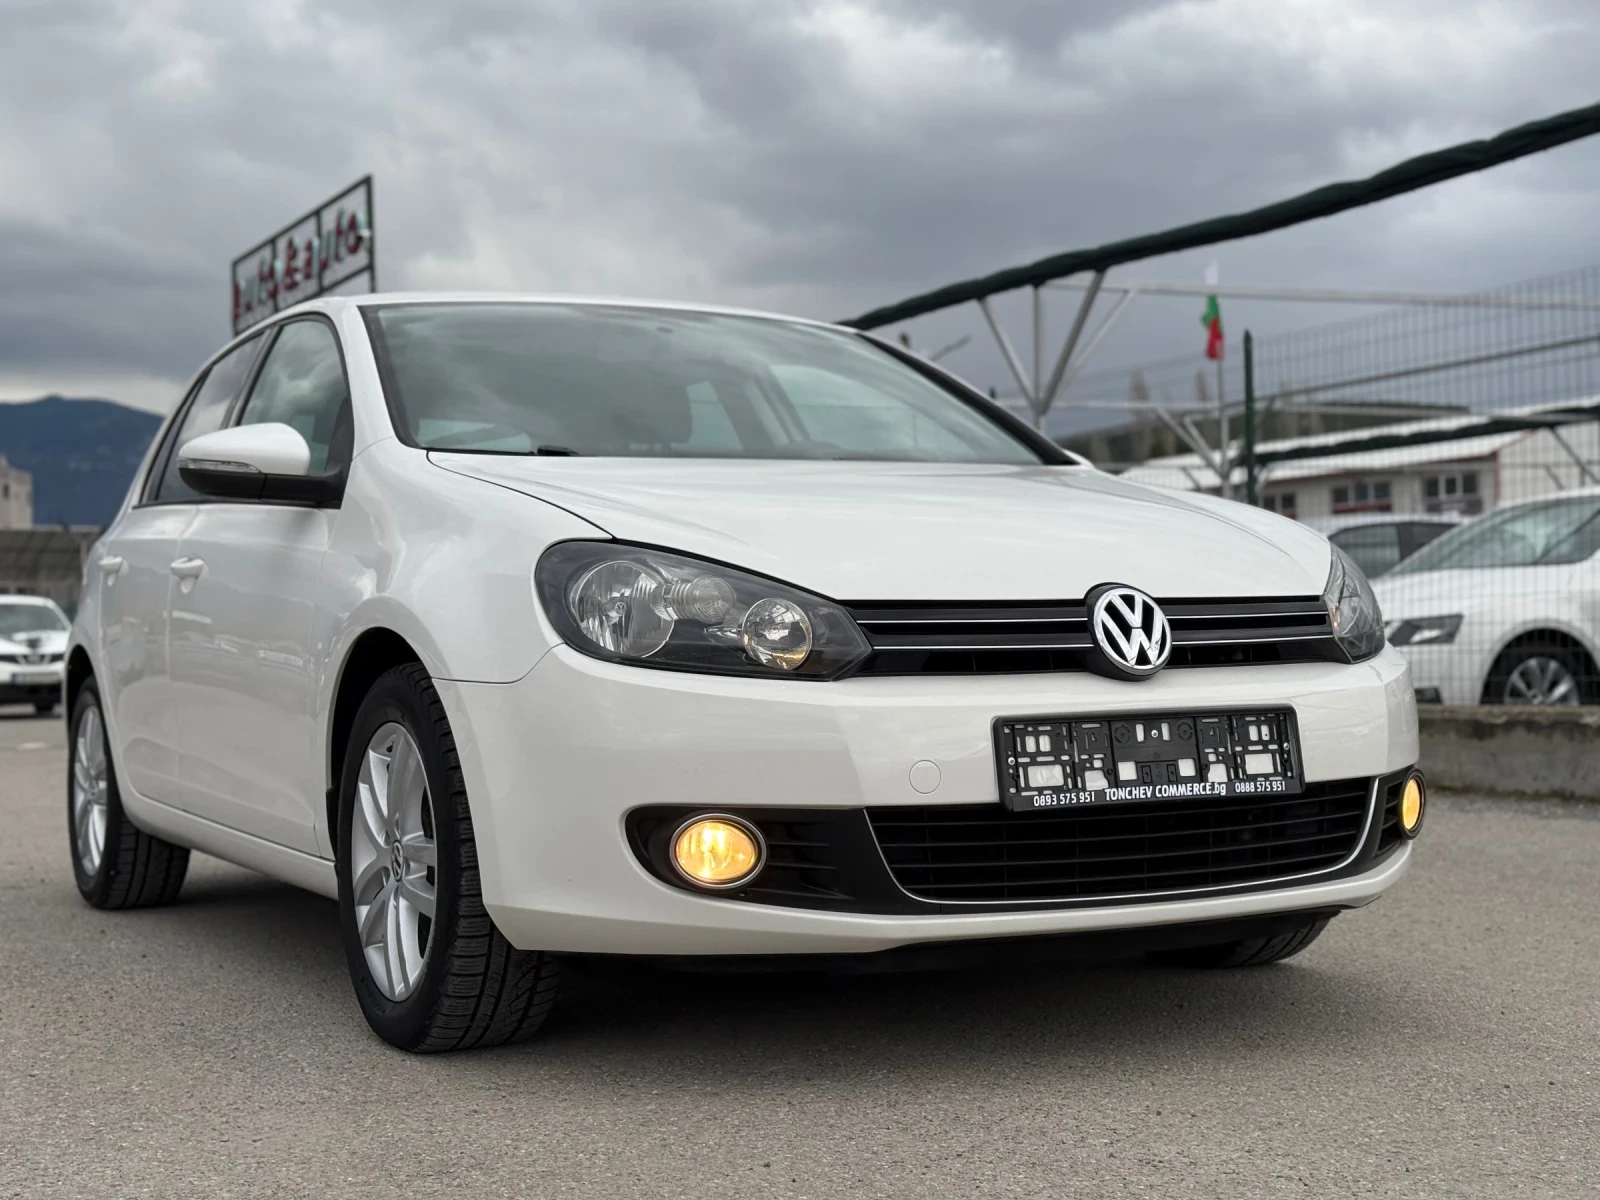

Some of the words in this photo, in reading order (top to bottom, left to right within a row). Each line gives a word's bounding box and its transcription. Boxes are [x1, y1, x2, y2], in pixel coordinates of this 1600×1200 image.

[1094, 587, 1172, 669] VW
[1033, 794, 1057, 807] 0893
[1059, 792, 1077, 804] 575
[1079, 791, 1095, 803] 951
[1104, 785, 1153, 801] TONCHEV
[1155, 782, 1227, 798] COMMERCE.bg
[1235, 782, 1255, 793] 0888
[1256, 781, 1271, 792] 575
[1272, 780, 1286, 791] 951
